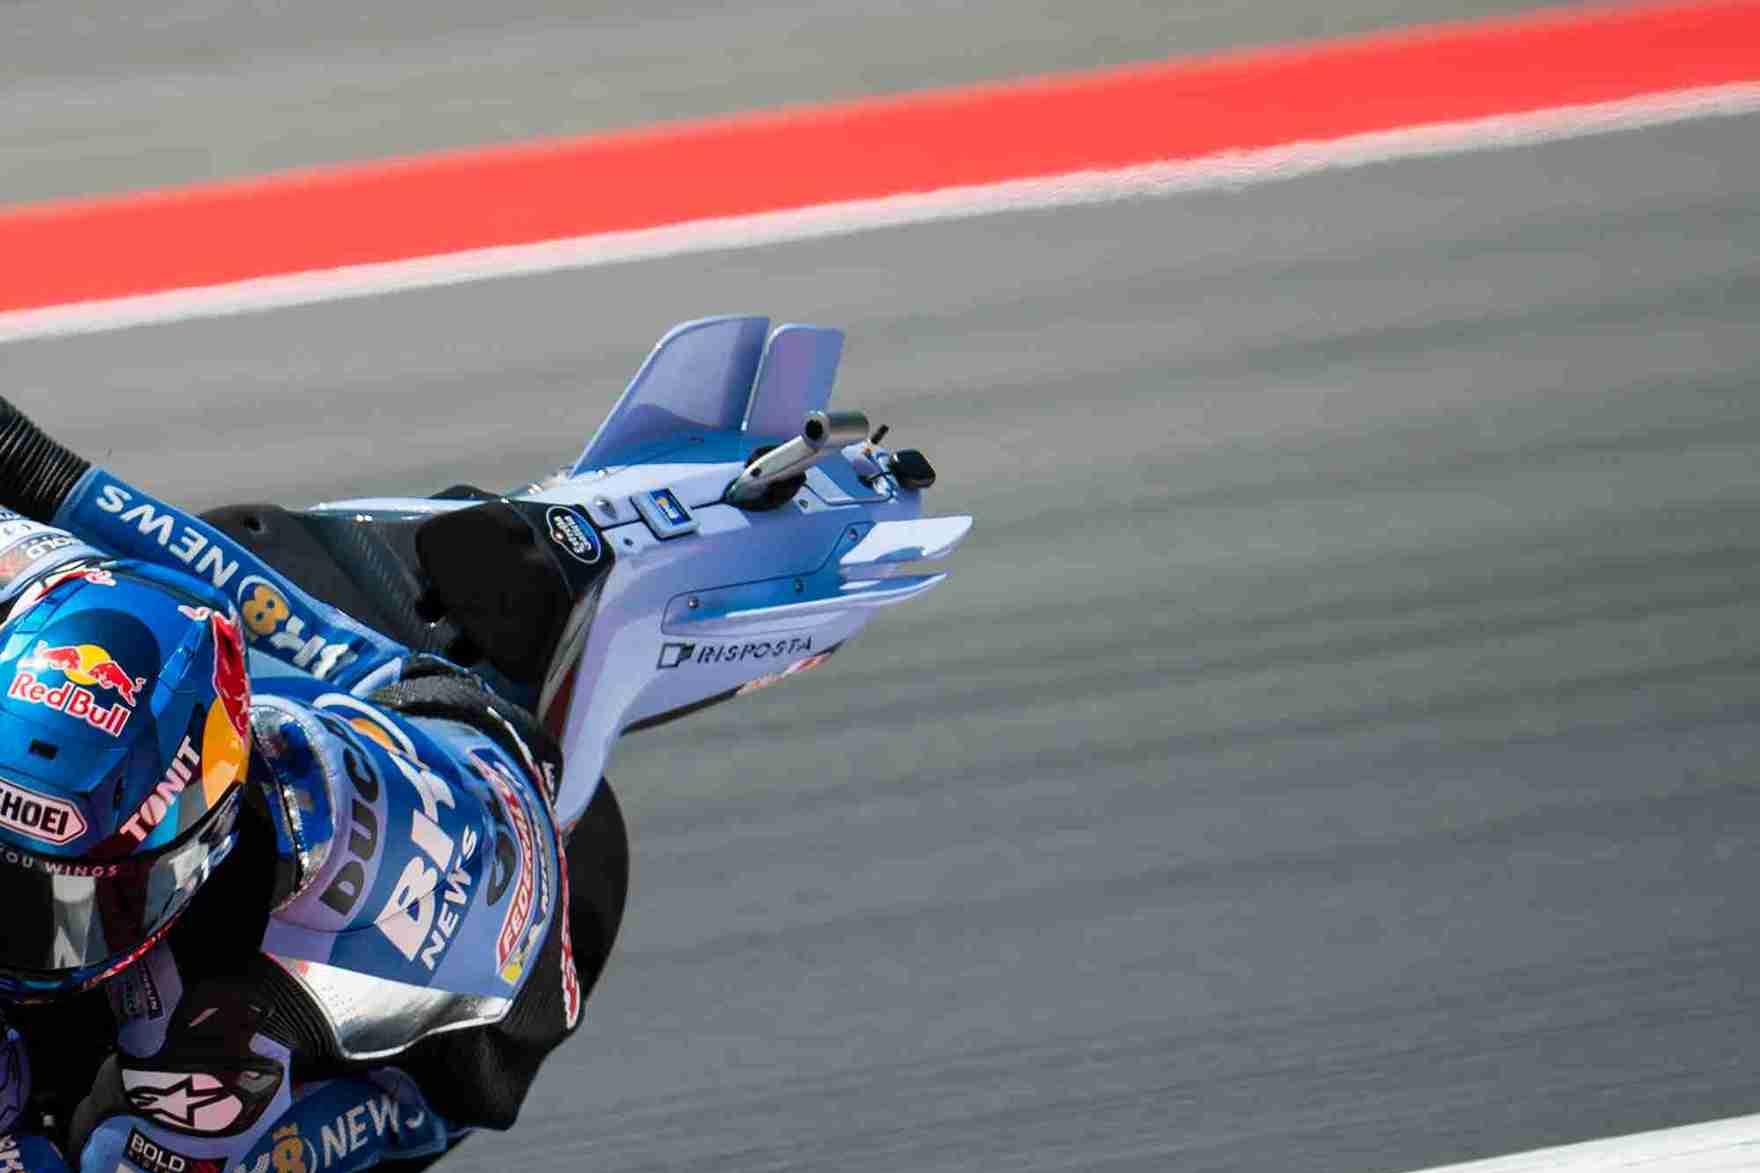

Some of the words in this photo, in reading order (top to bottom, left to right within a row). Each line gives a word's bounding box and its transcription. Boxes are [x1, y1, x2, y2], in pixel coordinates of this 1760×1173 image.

[97, 483, 240, 590] NEWS
[696, 636, 815, 666] RISPOSTA
[7, 671, 67, 712] Red
[66, 692, 132, 738] Bull
[119, 735, 201, 842] TONIT
[420, 825, 478, 971] NEWS
[130, 1132, 186, 1173] BOLD
